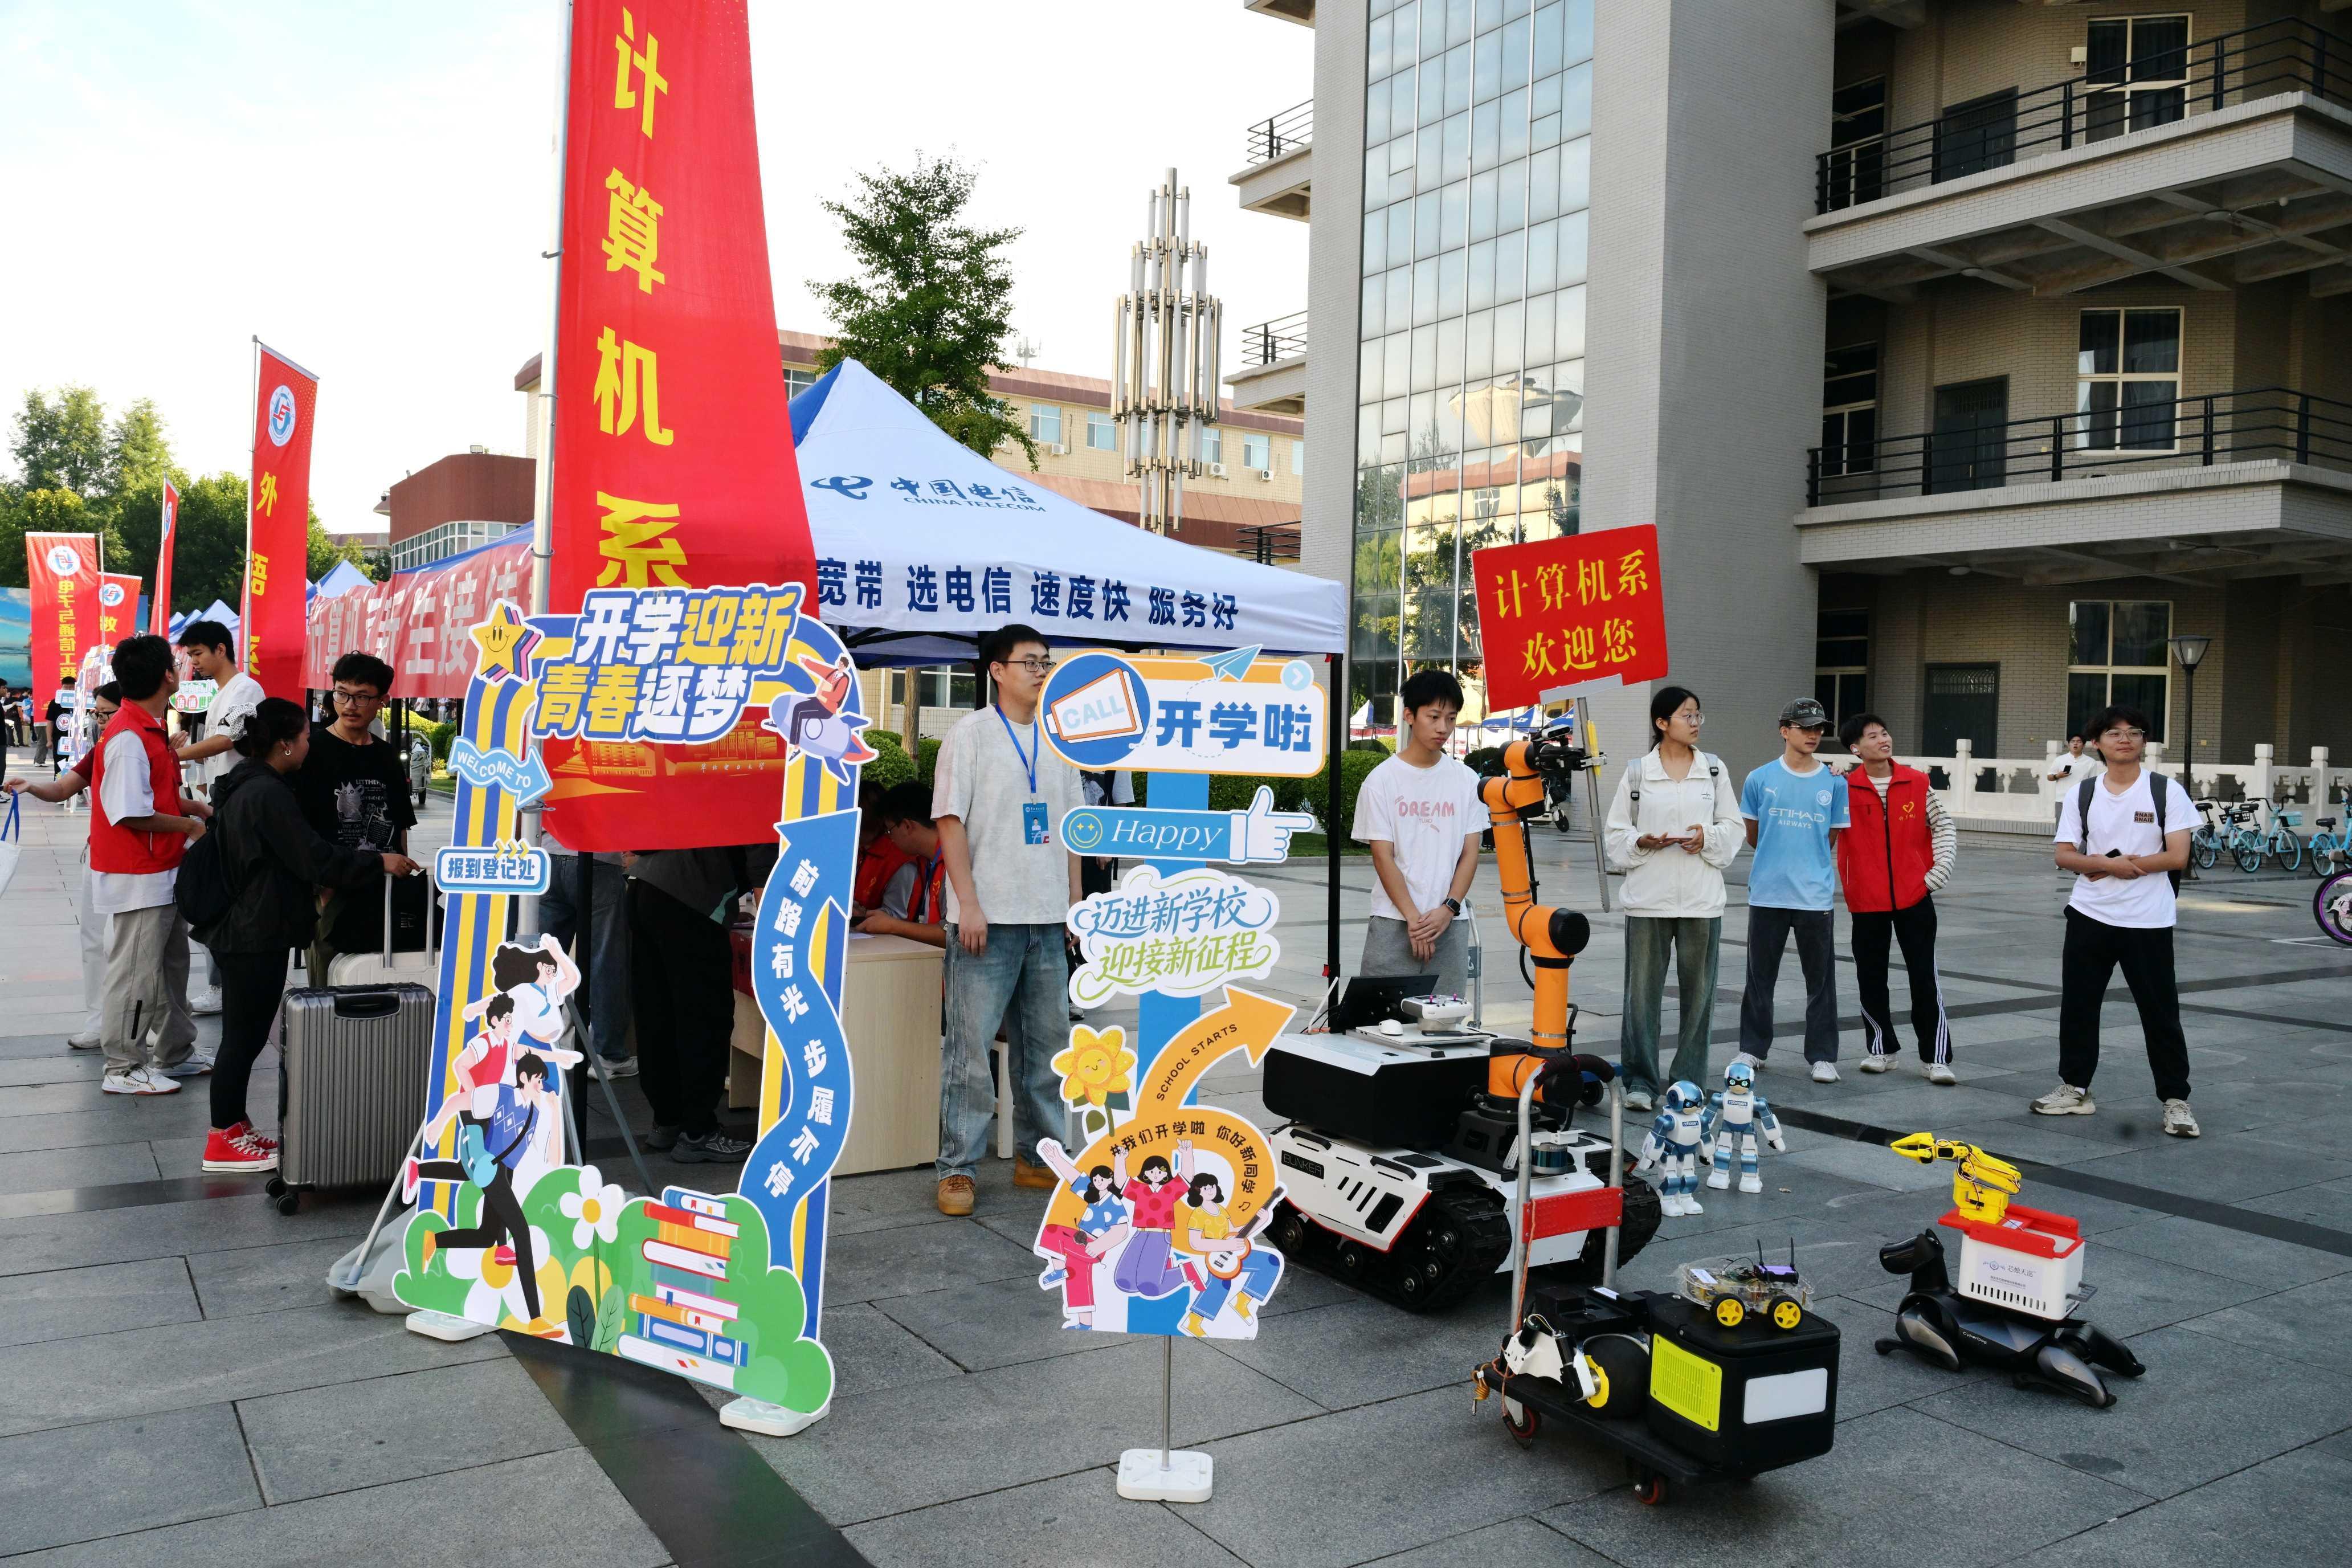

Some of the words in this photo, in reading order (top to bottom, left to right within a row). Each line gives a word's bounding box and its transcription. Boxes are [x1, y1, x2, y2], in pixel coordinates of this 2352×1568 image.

[593, 6, 691, 588] 计算机系
[891, 476, 1038, 505] 中国电信
[903, 497, 962, 506] CHINA
[963, 500, 1046, 513] TELECOM
[907, 564, 1012, 614] 选电信
[1030, 571, 1130, 623] 速度快
[1148, 586, 1239, 632] 服务好
[1492, 549, 1648, 620] 计算机系
[574, 592, 800, 666] 开学迎新
[1522, 618, 1637, 680] 欢迎您
[536, 662, 750, 736] 青春逐梦
[1061, 695, 1126, 730] CALL
[1156, 700, 1312, 753] 开学啦
[458, 752, 514, 780] WELCOME
[515, 773, 531, 788] TO
[1399, 801, 1454, 817] DREAM
[1769, 807, 1826, 823] ETIHAD
[1778, 819, 1812, 830] AIRWAYS
[1110, 820, 1223, 852] Happy
[447, 856, 536, 881] 报到登记处
[1087, 885, 1248, 939] 迈进新学校
[772, 859, 820, 1024] 前路有光
[1099, 930, 1257, 982] 迎接新征程
[1156, 1057, 1190, 1101] SCHOOL
[1191, 1023, 1238, 1055] STARTS
[764, 1039, 834, 1199] 步履不停
[1216, 1125, 1258, 1194] 你好新同学
[1284, 1153, 1322, 1177] BUNKER
[1963, 1332, 1987, 1345] CyberDog
